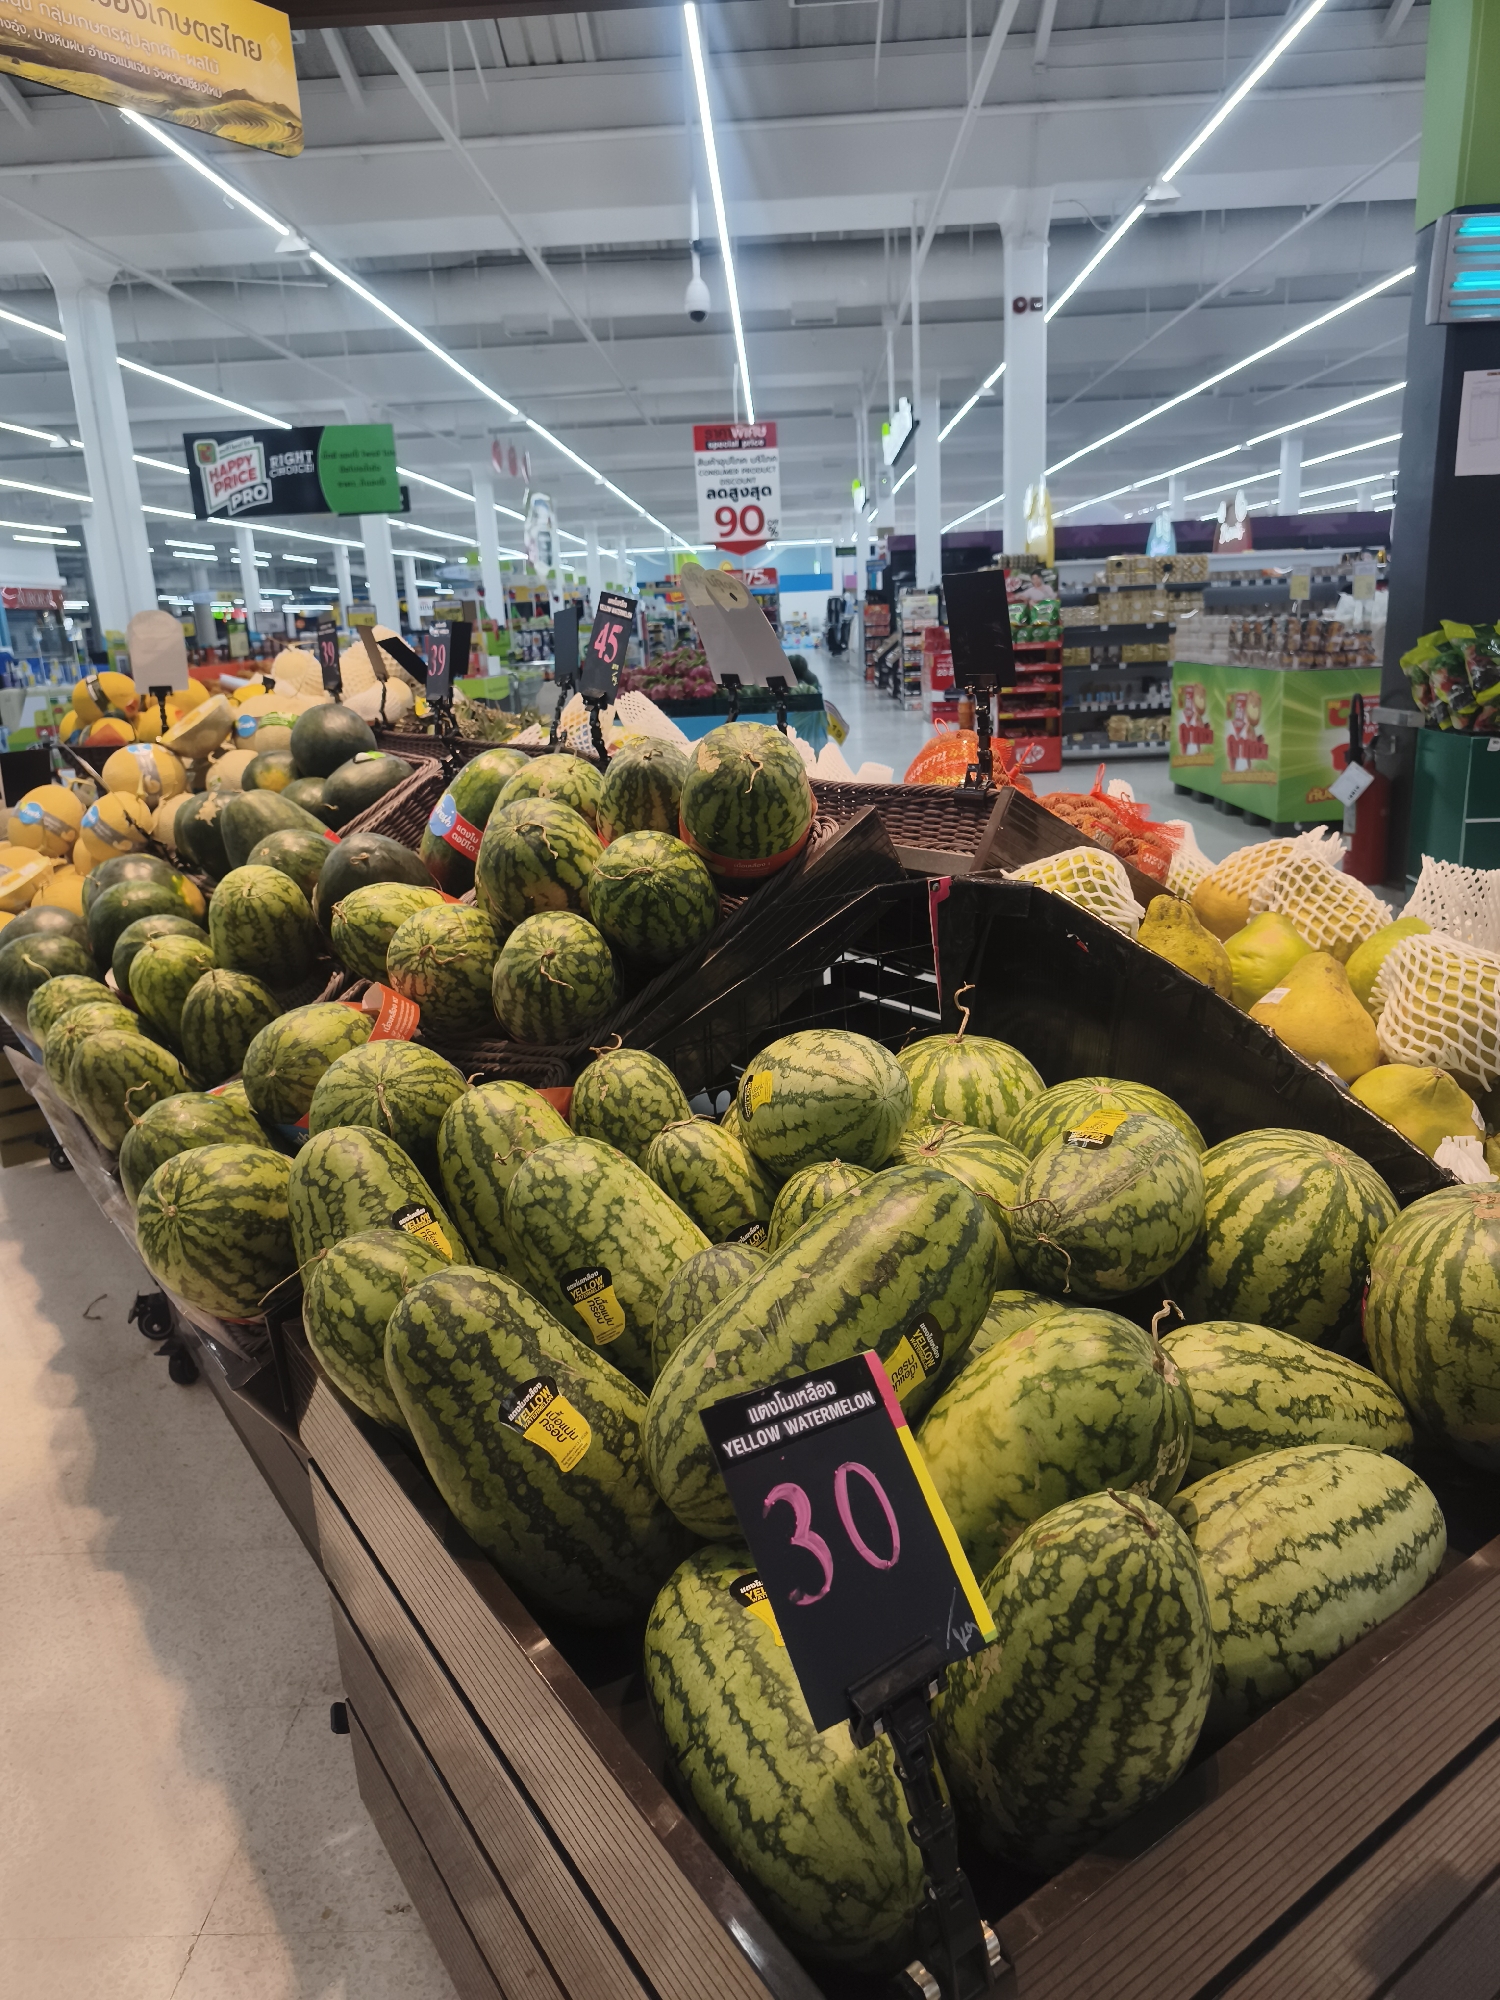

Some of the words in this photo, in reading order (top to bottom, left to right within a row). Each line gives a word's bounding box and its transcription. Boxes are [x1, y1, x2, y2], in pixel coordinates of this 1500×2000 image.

[208, 454, 253, 482] HAPPY
[269, 450, 314, 468] RIGHT
[213, 467, 257, 498] PRICE
[231, 485, 268, 510] PRO
[706, 486, 772, 502] ลดสูงสุด
[715, 504, 765, 538] 90
[320, 641, 335, 667] 39
[594, 621, 623, 664] 45
[428, 644, 447, 677] 39
[569, 1274, 603, 1300] YELLOW
[587, 1300, 605, 1325] กรอบ
[912, 1328, 936, 1368] YELLOW
[891, 1354, 915, 1383] กรอบ
[514, 1385, 551, 1428] YELLOW
[747, 1380, 838, 1424] แตงโมเหลือง
[538, 1418, 568, 1443] กรอบ
[545, 1409, 579, 1441] เนื้อแน่น
[722, 1424, 782, 1460] YELLOW
[783, 1390, 877, 1436] WATERMELON
[762, 1460, 901, 1607] 30
